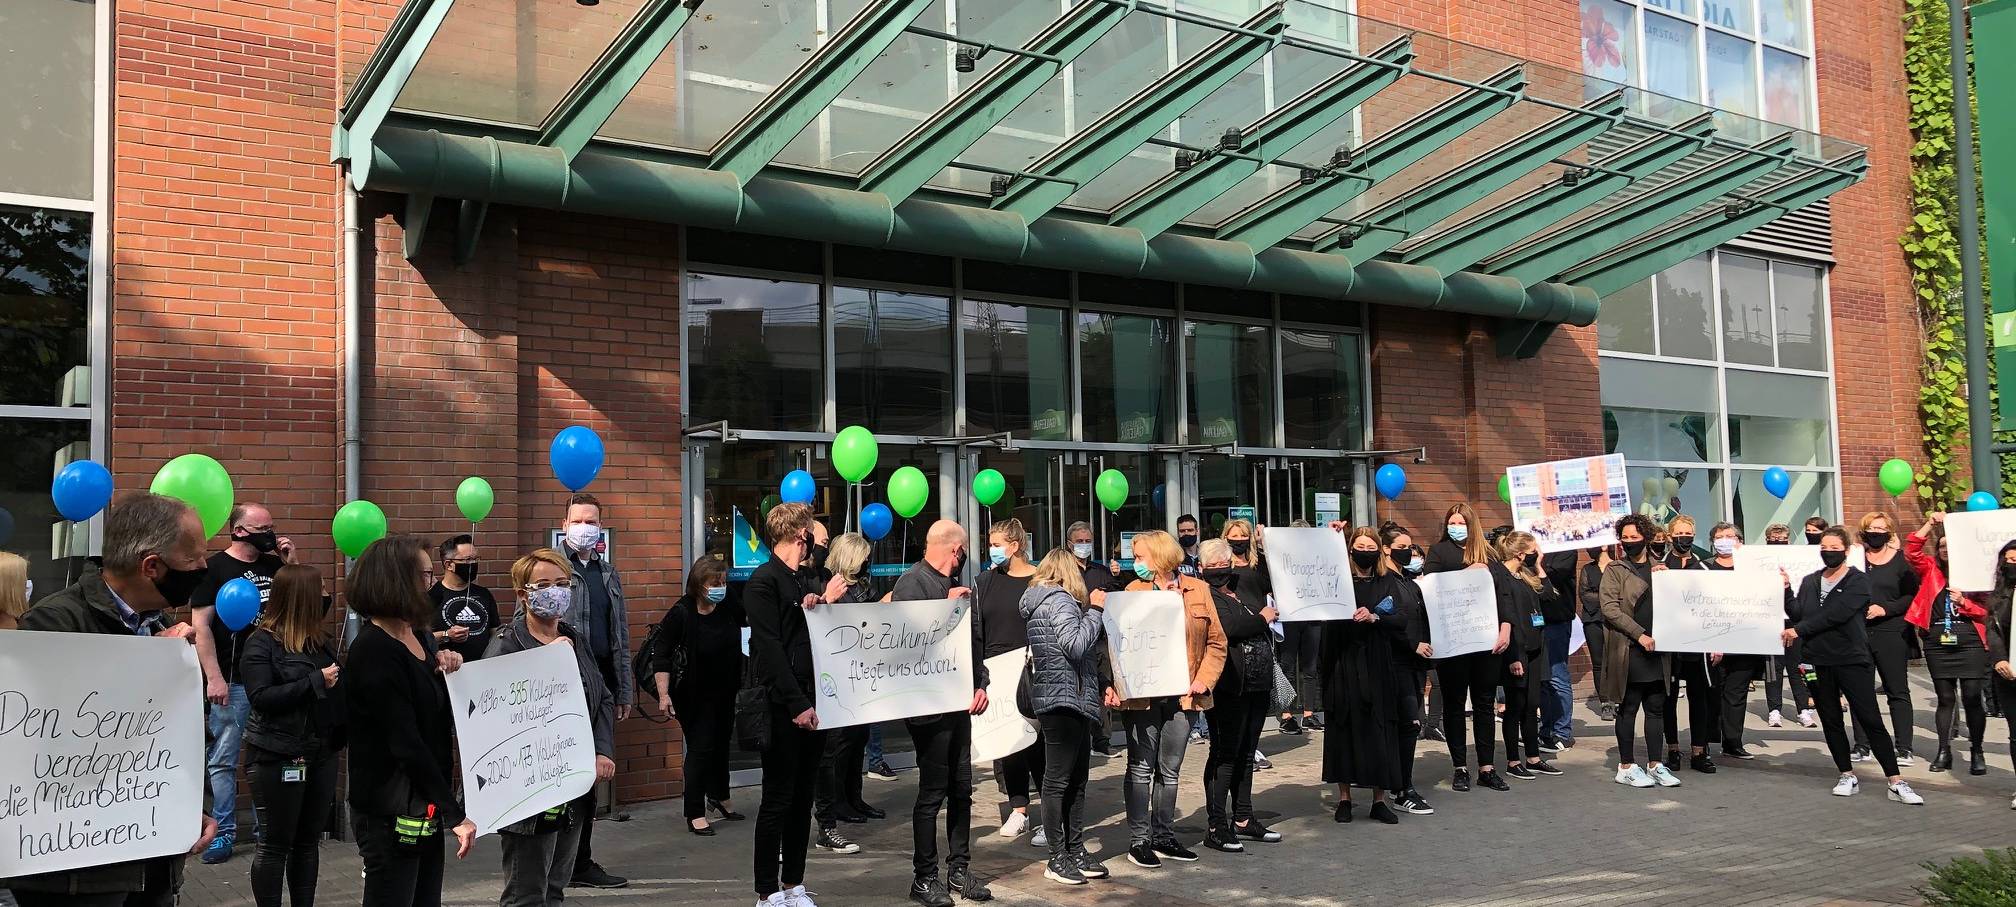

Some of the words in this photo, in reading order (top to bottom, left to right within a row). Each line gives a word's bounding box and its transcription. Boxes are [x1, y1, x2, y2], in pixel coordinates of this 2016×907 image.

[825, 621, 875, 655] Die
[879, 620, 942, 660] Zukunft
[848, 660, 885, 692] fliegt
[888, 662, 911, 678] uns
[913, 648, 957, 677] davon!
[0, 690, 61, 739] Den
[72, 690, 165, 739] Service
[508, 679, 529, 706] 385
[510, 710, 523, 725] und
[525, 704, 553, 728] Kollegen
[34, 738, 180, 794] verdoppeln
[487, 755, 512, 786] 2020
[535, 734, 577, 766] Kolleginnen
[523, 772, 535, 788] und
[541, 762, 572, 788] Kollegen
[0, 784, 28, 820] die
[34, 776, 170, 814] Mitarbeiter
